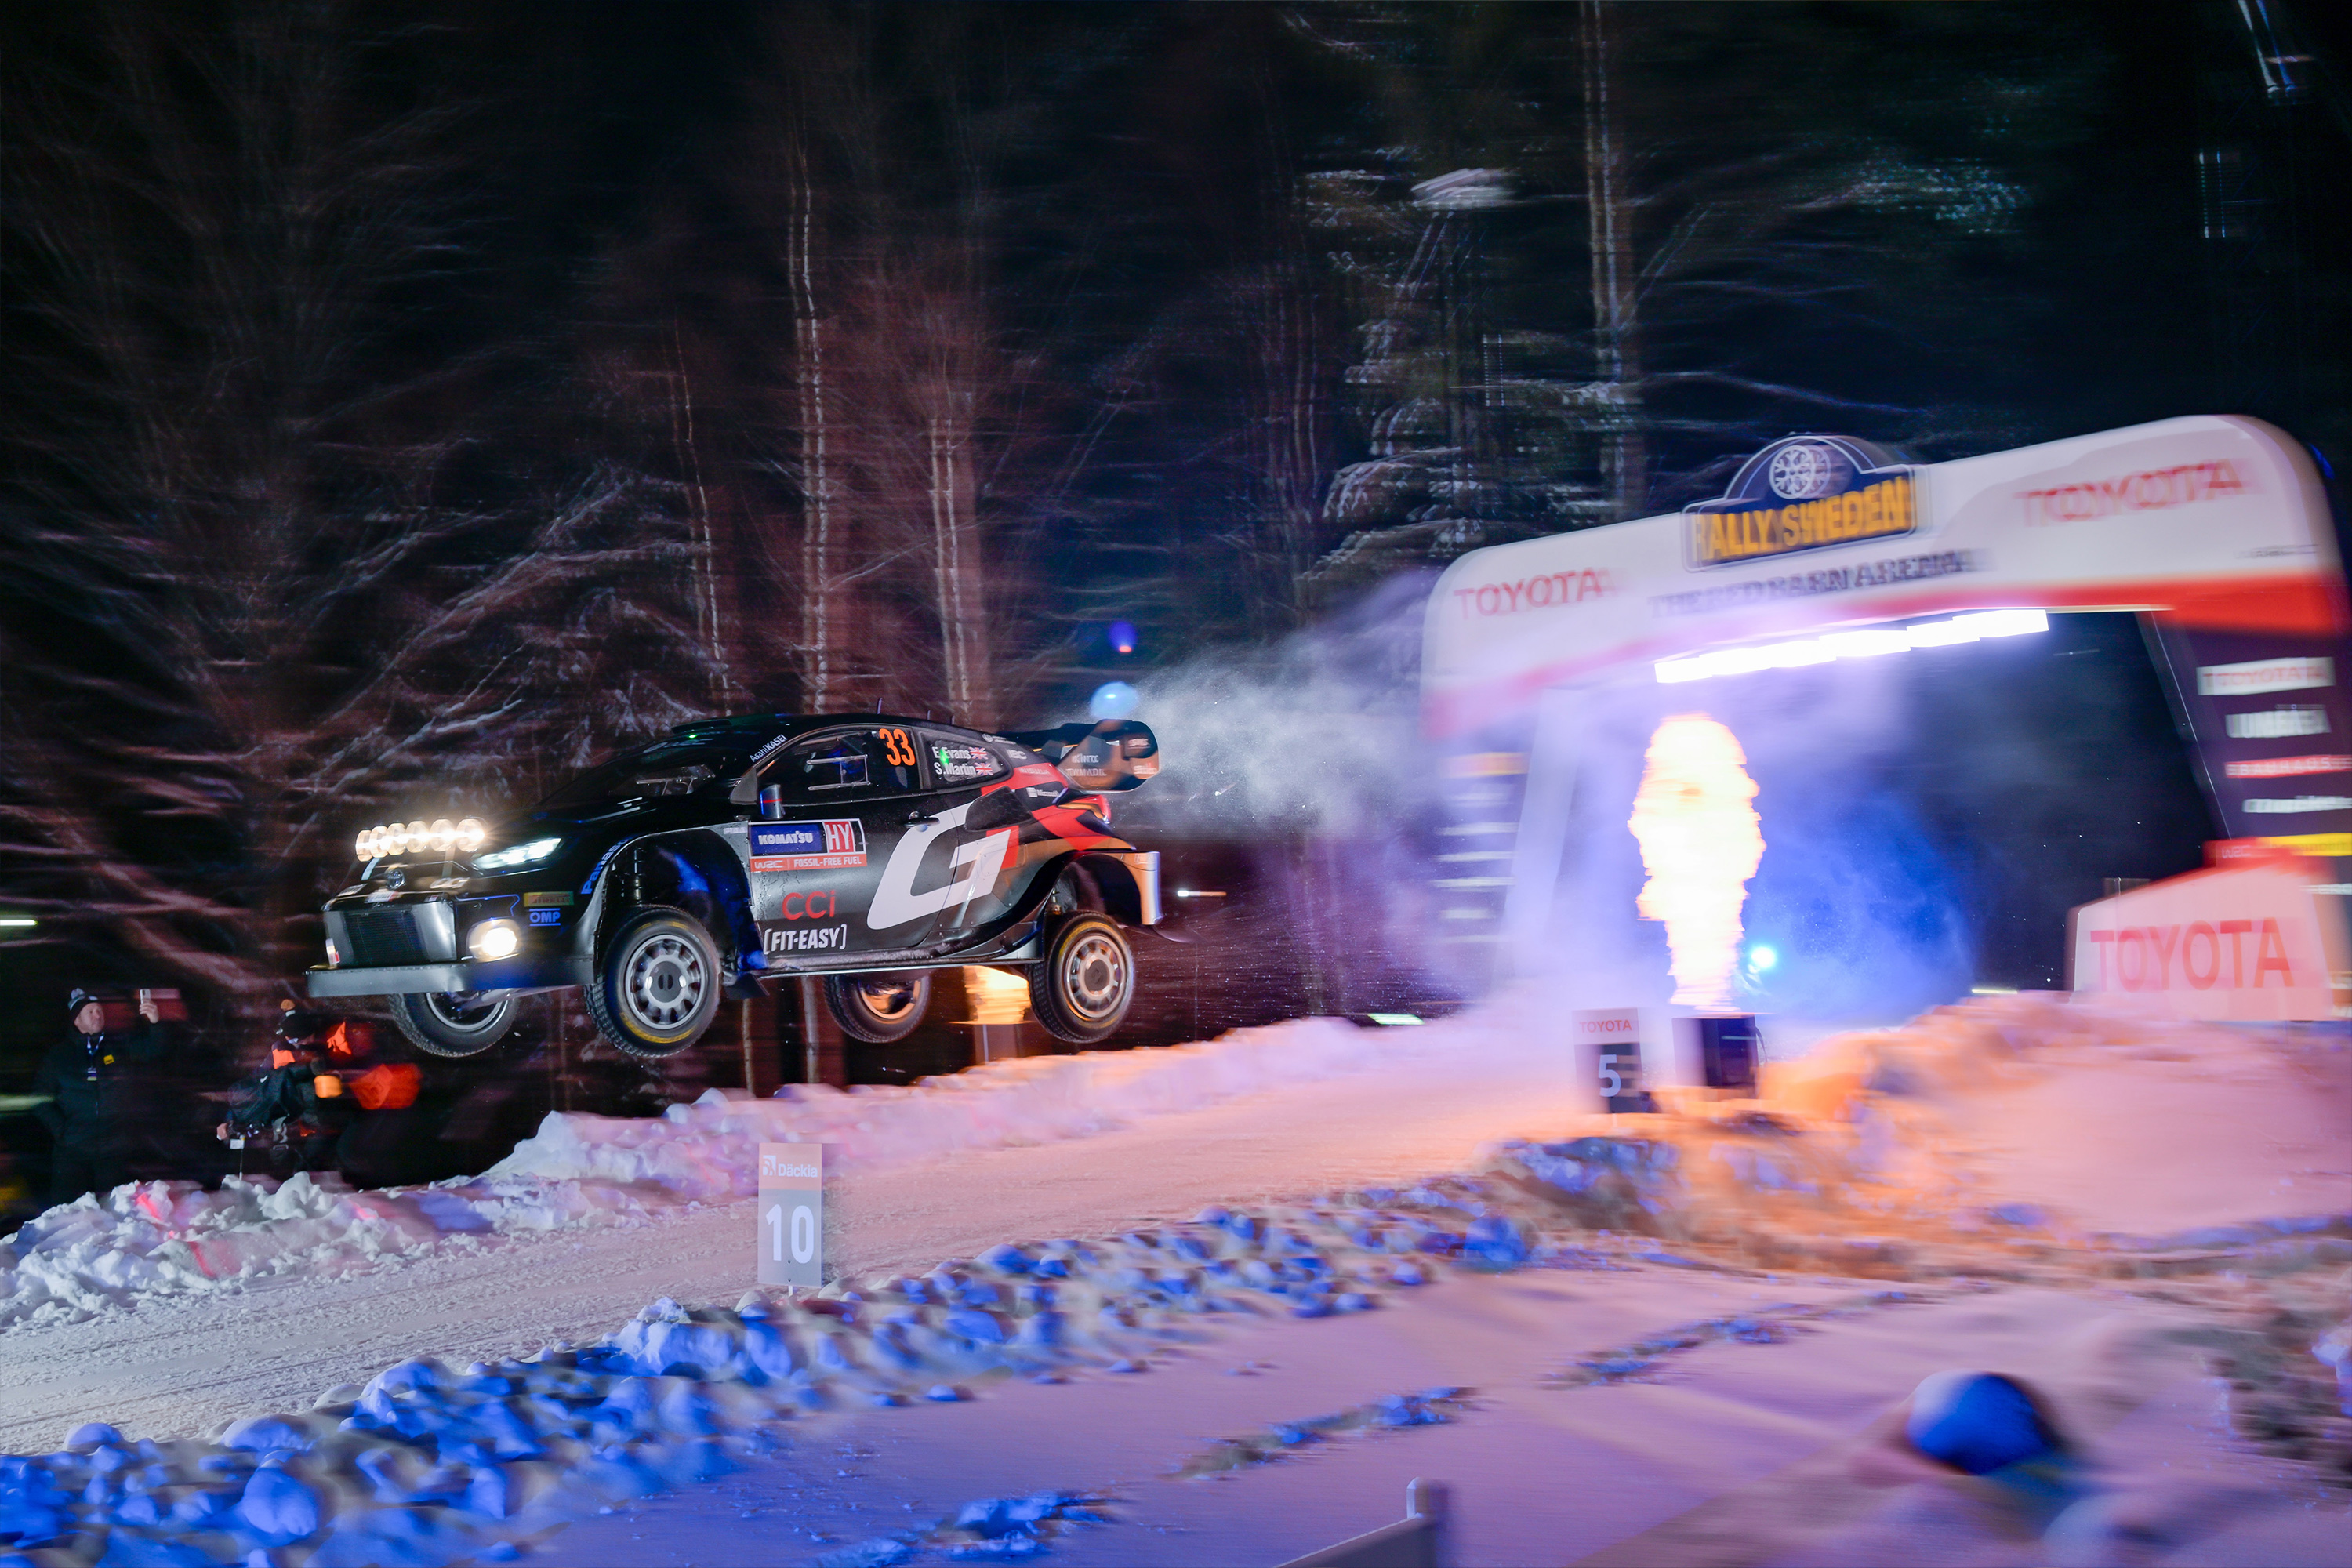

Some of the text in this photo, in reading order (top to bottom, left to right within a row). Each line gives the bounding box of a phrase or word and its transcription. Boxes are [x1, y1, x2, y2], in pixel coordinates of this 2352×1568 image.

[1781, 476, 1913, 546] SWEDEN
[1454, 568, 1609, 620] TOYOTA
[749, 734, 788, 762] AsahiKASEI
[879, 728, 916, 766] 33
[932, 746, 971, 760] EEvans
[758, 831, 814, 844] KOMATSU
[826, 824, 851, 850] HY
[793, 856, 862, 869] FOSSIL-FREE FUEL
[529, 911, 561, 924] OMP
[2090, 917, 2295, 993] TOYOTA
[1579, 1020, 1632, 1033] TOYOTA
[1599, 1054, 1621, 1098] 5
[778, 1163, 818, 1178] Däckia
[766, 1204, 815, 1264] 10
